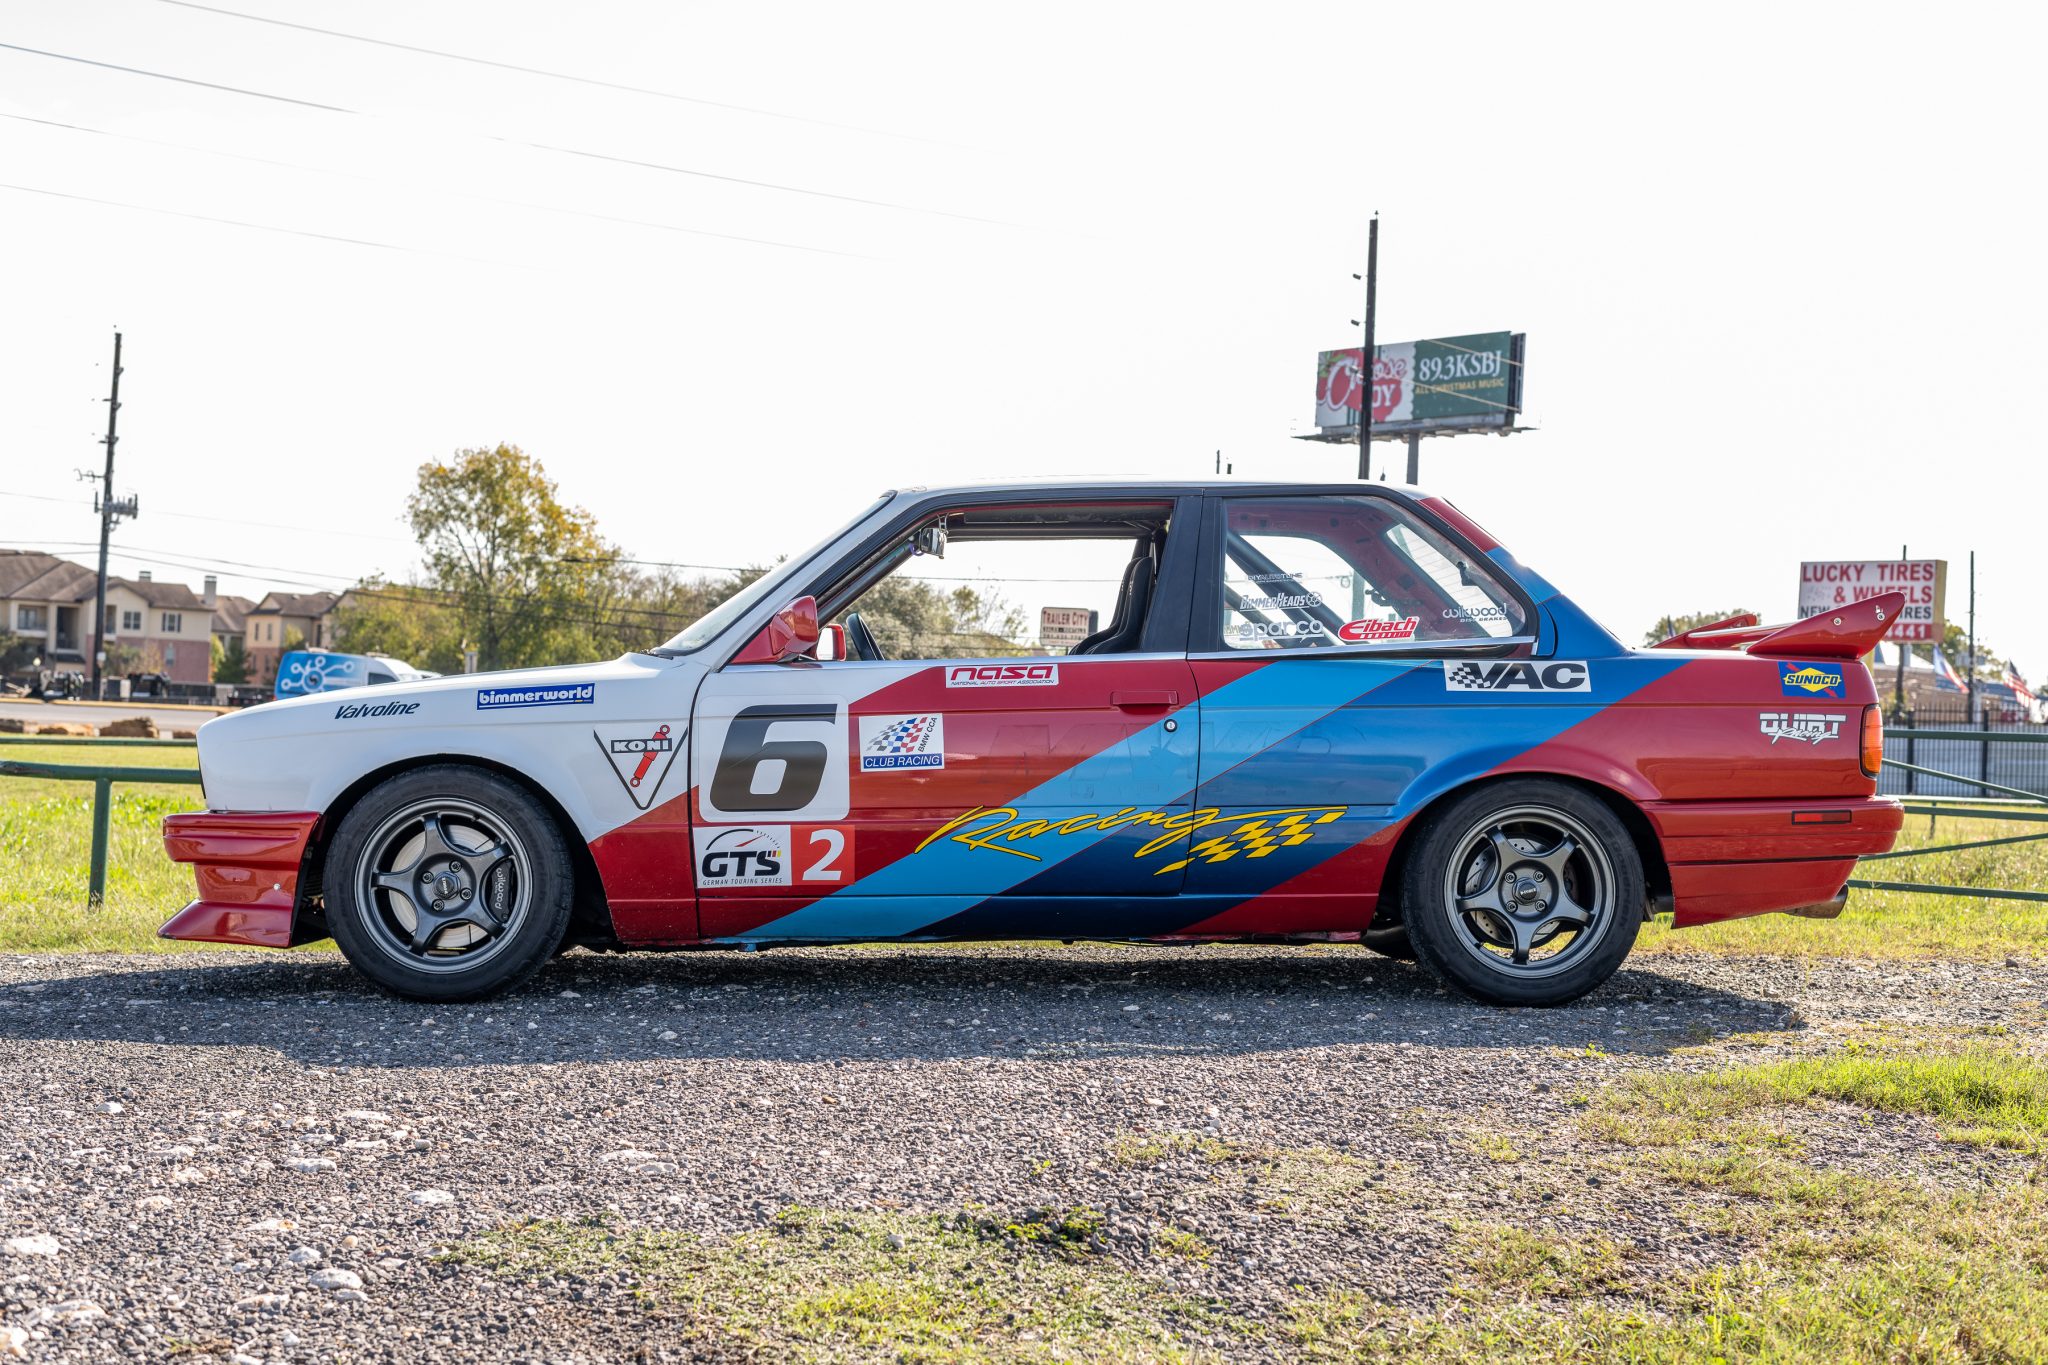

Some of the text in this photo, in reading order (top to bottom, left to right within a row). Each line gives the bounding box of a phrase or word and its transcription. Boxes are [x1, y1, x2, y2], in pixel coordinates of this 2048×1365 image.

[1415, 378, 1504, 394] ALL CHRISTMAS MUSIC
[1802, 563, 1934, 582] LUCKY TIRES
[1834, 585, 1932, 604] & WHLS
[1043, 610, 1088, 626] TRAILER CITY
[1240, 620, 1324, 642] sparco
[1339, 617, 1416, 640] Eibach
[951, 665, 1054, 680] nasa
[1458, 662, 1586, 690] VAC
[1786, 674, 1840, 686] SUNOCO
[480, 686, 593, 704] bimmerworld
[334, 701, 421, 720] Valvoline
[917, 716, 938, 753] BMW CCA
[613, 740, 669, 752] KONI
[710, 703, 838, 813] 6
[865, 755, 940, 768] CLUB RACING
[914, 805, 1348, 861] Racing
[702, 850, 781, 878] GTS
[802, 828, 845, 881] 2
